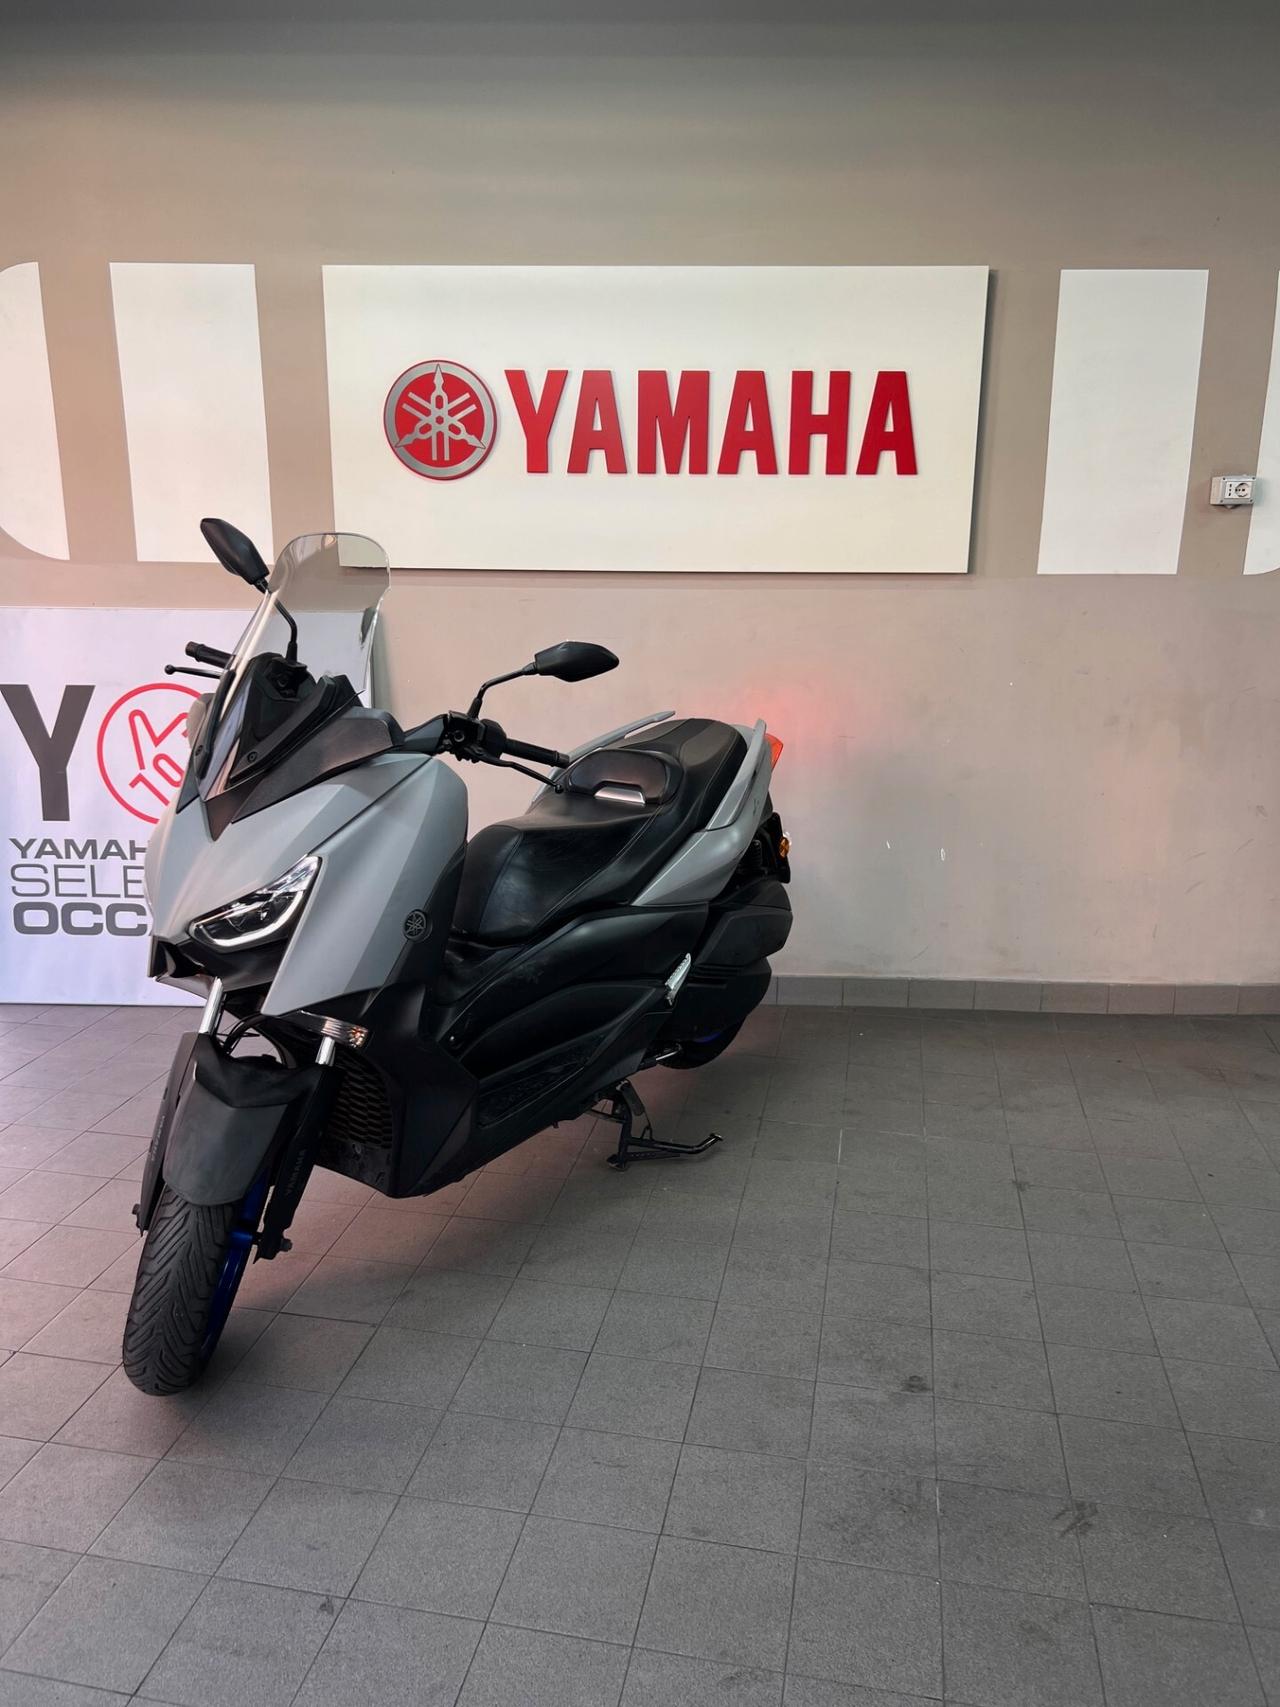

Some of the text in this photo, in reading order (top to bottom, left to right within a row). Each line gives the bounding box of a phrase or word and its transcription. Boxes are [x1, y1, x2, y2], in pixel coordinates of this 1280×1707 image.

[504, 370, 918, 475] YAMAHA
[9, 838, 150, 860] YAMAH
[10, 863, 145, 898] SELE
[13, 902, 151, 936] OCC
